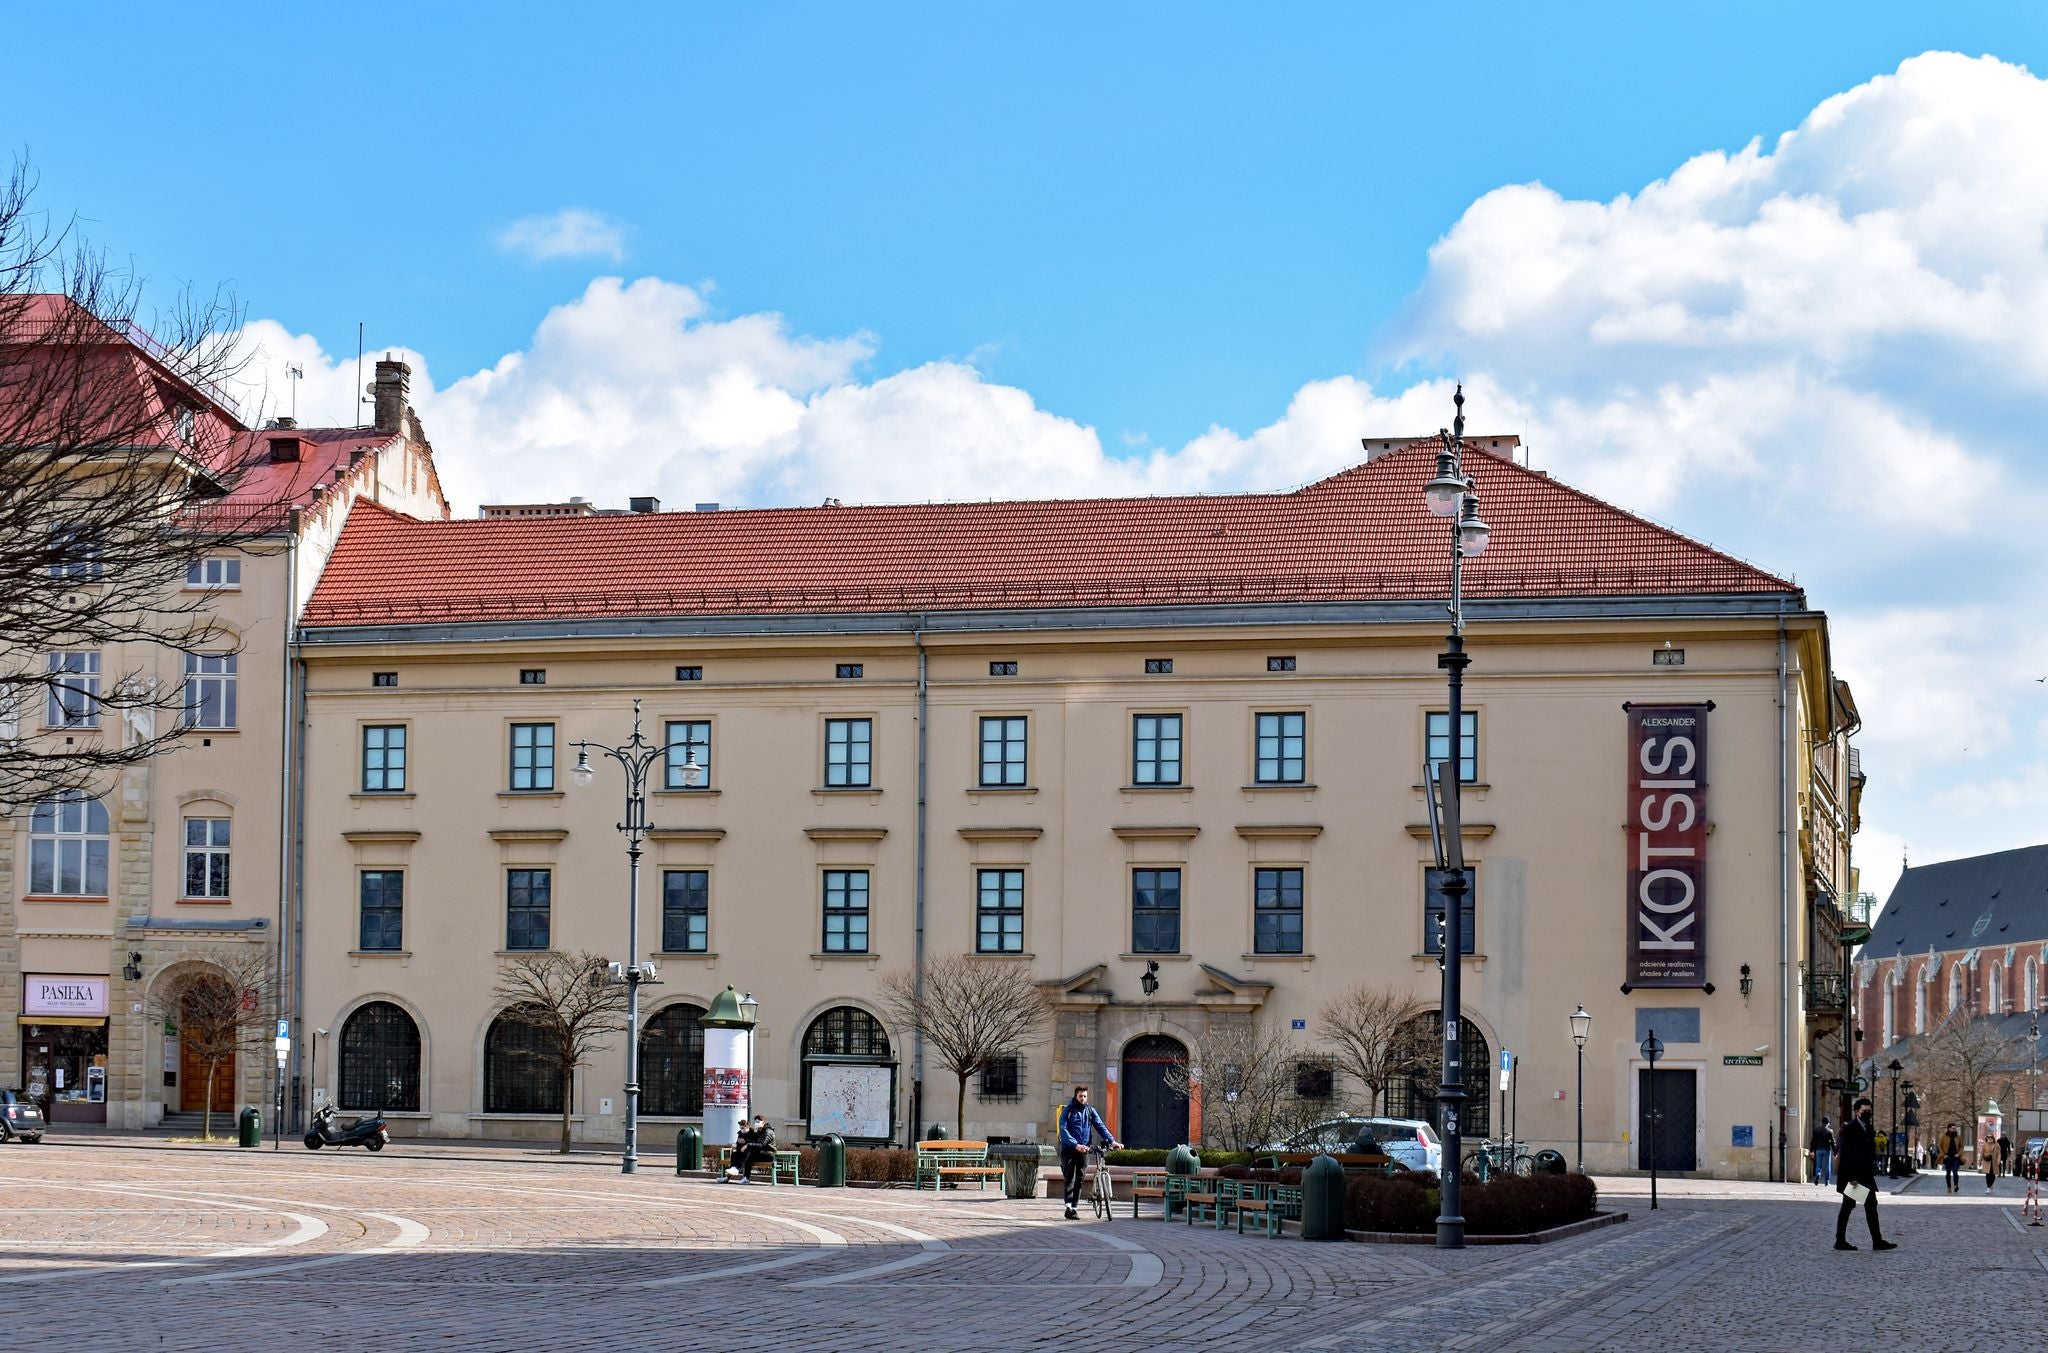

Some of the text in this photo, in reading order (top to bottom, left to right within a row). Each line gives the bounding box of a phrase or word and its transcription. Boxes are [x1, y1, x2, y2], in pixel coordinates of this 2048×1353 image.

[1641, 718, 1696, 727] ALEKSANDER
[1639, 736, 1696, 951] KOTSIS
[41, 985, 93, 1000] PASIEKA
[280, 1023, 286, 1036] P
